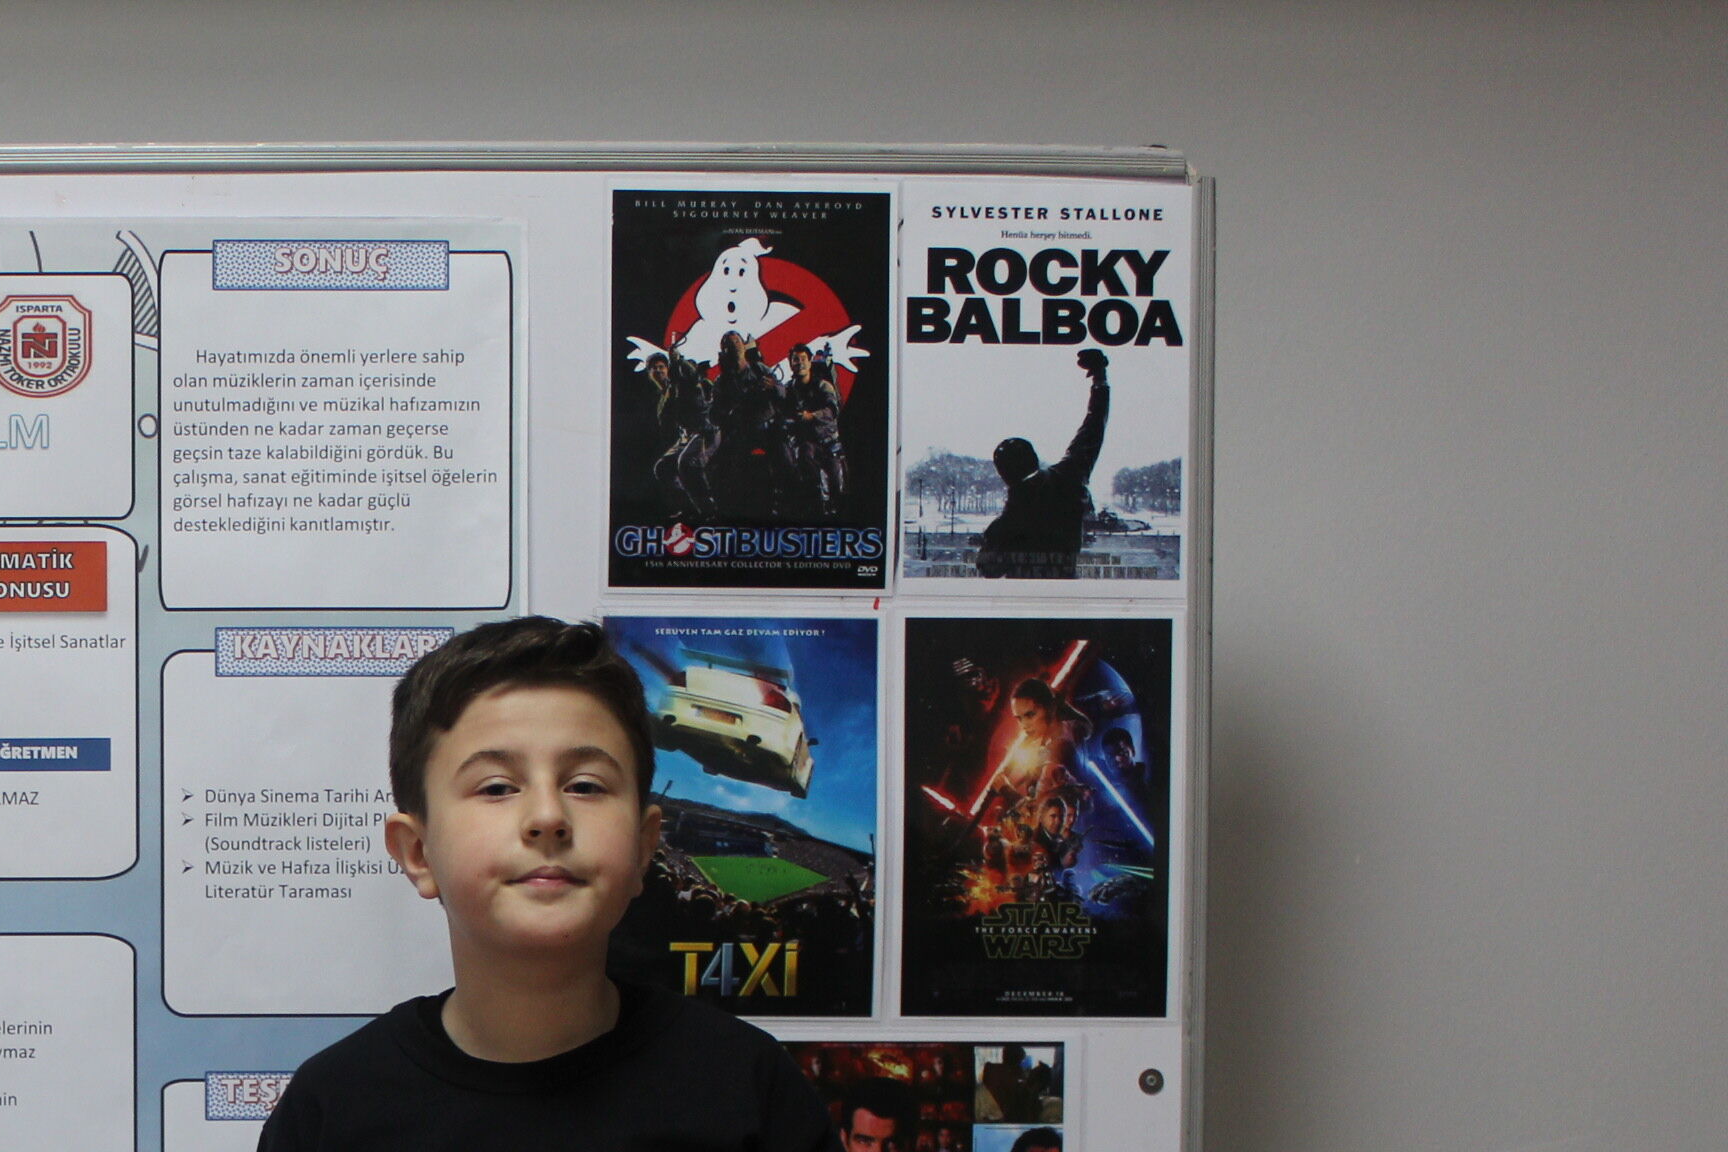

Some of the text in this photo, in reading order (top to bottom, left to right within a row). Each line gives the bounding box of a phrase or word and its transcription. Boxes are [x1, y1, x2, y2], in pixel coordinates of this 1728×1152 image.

[931, 206, 1163, 221] SYLVESTER STALLONE
[273, 247, 390, 281] SONUÇ
[927, 247, 1171, 297] ROCKY
[15, 305, 63, 313] ISPARTA
[906, 297, 1183, 347] BALBOA
[28, 361, 52, 369] 1992
[172, 444, 453, 464] geçsin taze kalabildiğini gördük. Bu
[10, 631, 55, 652] İşitsel
[60, 634, 126, 649] Sanatlar
[233, 633, 438, 660] KAYNAKLAR
[205, 789, 256, 807] Dünya
[260, 789, 319, 803] Sinema
[323, 788, 369, 803] Tarihi
[204, 834, 373, 855] (Soundtrack listeleri)
[205, 884, 352, 899] Literatür Taraması
[982, 902, 1091, 927] STAR
[982, 934, 1091, 959] WARS
